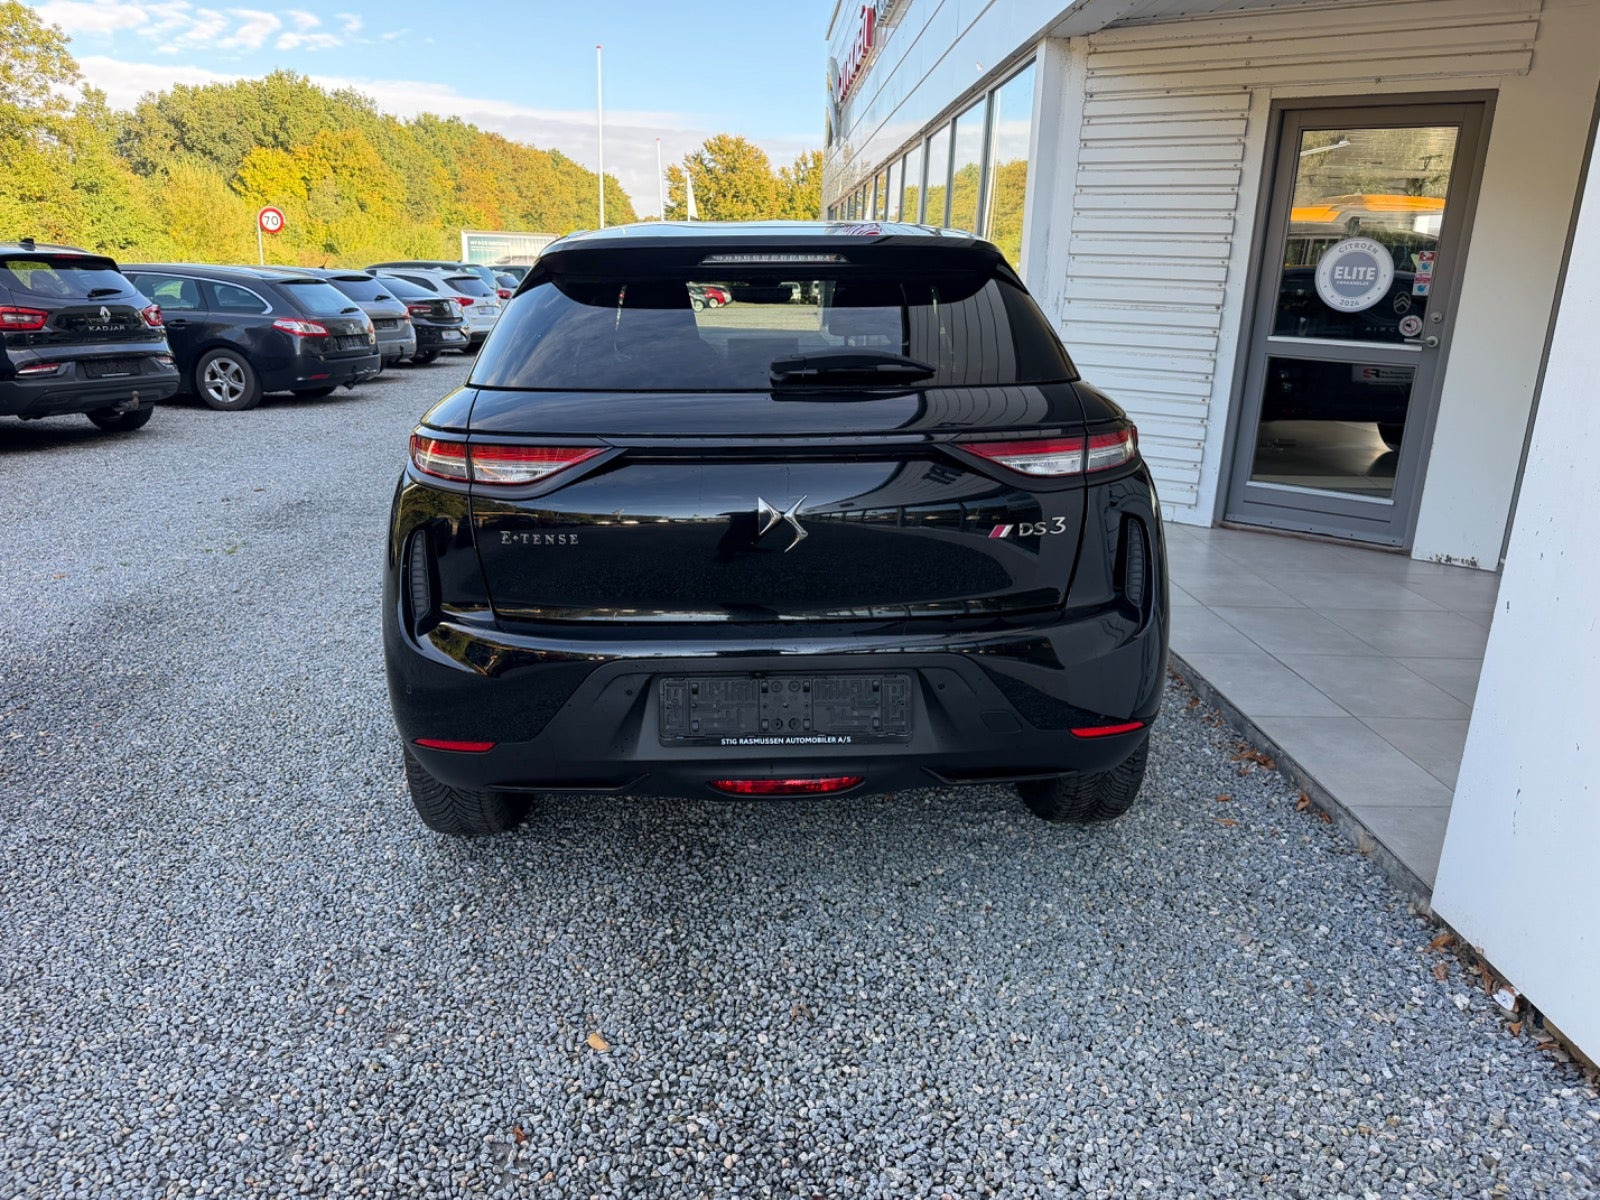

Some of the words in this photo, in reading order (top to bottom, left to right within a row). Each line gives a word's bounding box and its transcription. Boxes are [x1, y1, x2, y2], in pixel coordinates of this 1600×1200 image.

[264, 215, 279, 226] 70
[1334, 266, 1376, 280] ELITE
[88, 324, 126, 332] KADJAR
[721, 738, 737, 746] STIG
[738, 737, 784, 745] RASMUSSEN
[785, 737, 836, 745] AUTOMOBILER
[837, 736, 852, 744] A/S
